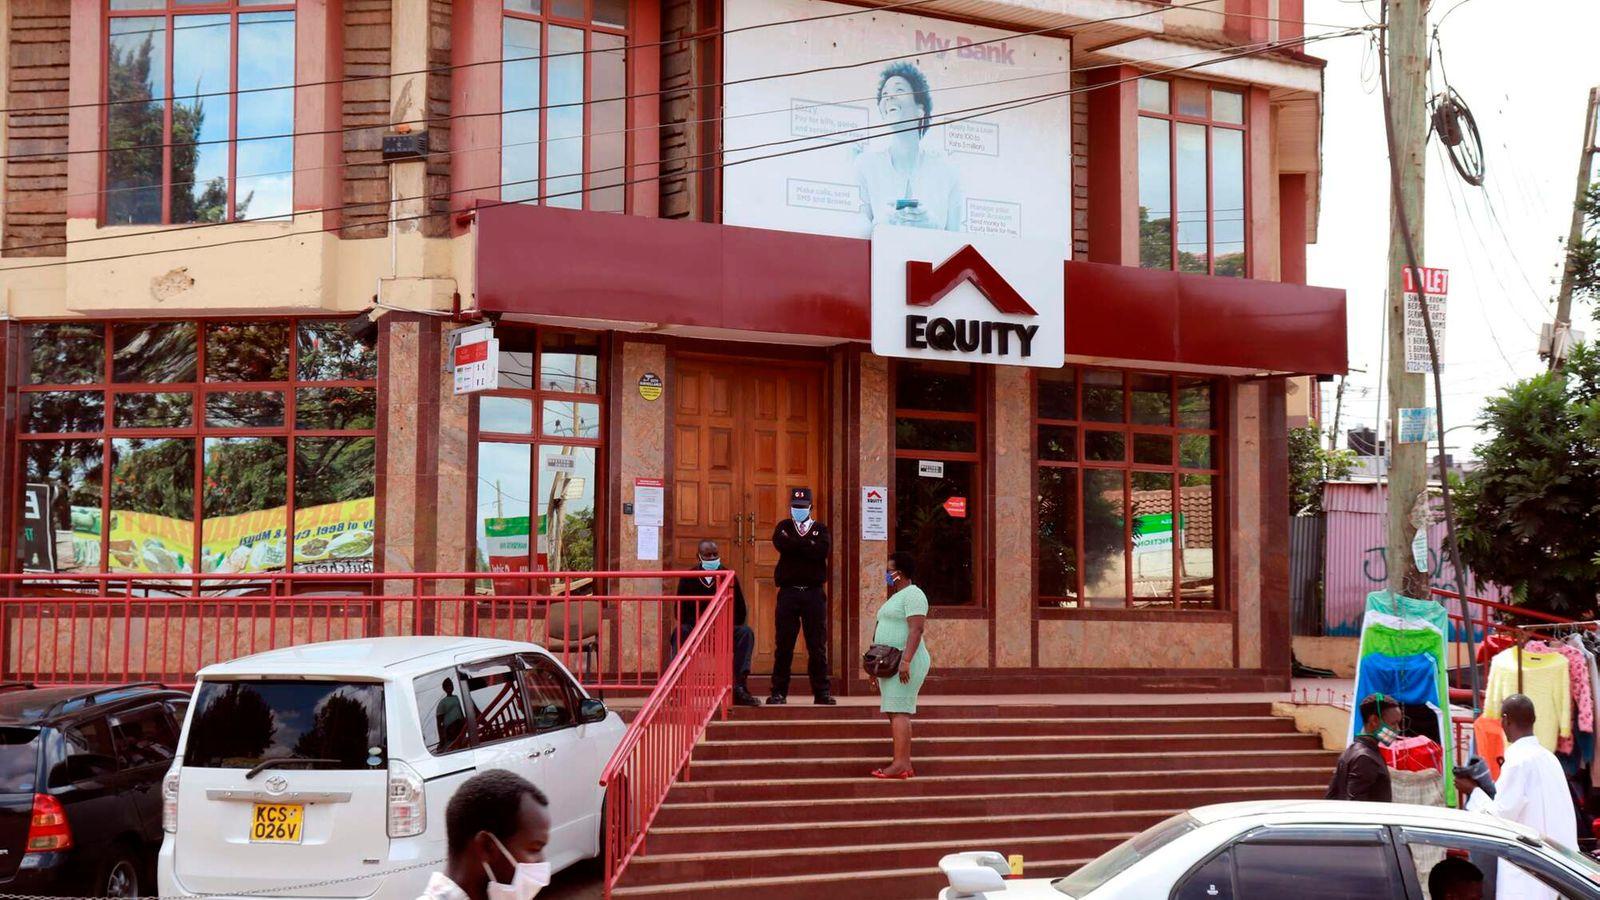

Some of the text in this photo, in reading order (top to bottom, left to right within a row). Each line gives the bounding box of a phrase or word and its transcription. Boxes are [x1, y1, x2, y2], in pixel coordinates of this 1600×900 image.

[915, 30, 1015, 65] My Bank
[1426, 269, 1447, 293] LET
[906, 315, 1040, 357] EQUITY
[256, 806, 287, 822] KCS
[255, 823, 297, 840] 026V
